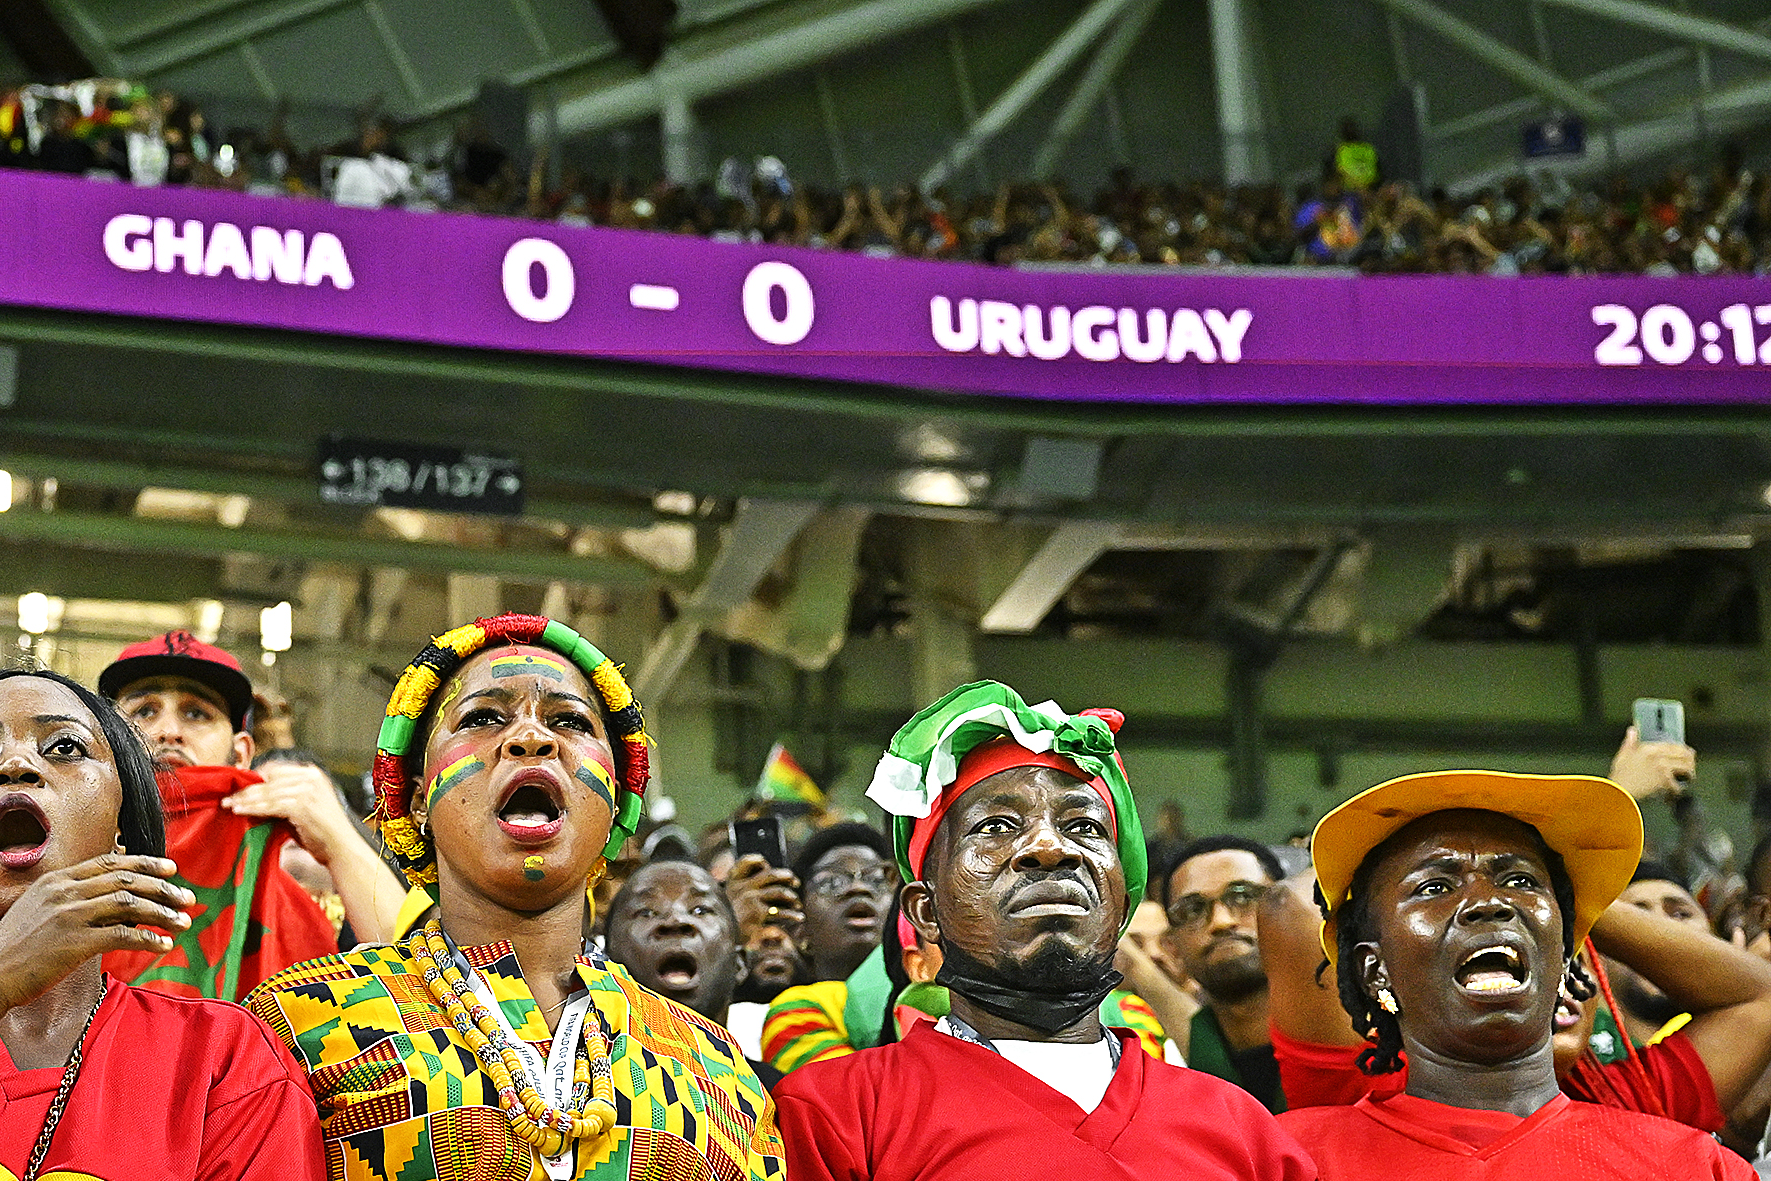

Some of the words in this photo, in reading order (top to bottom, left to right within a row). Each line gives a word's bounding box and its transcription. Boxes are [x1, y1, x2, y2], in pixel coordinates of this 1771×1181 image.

[103, 213, 355, 290] GHANA
[502, 237, 575, 323] 0
[629, 283, 679, 311] -
[742, 261, 815, 345] 0
[930, 295, 1254, 364] URUGUAY
